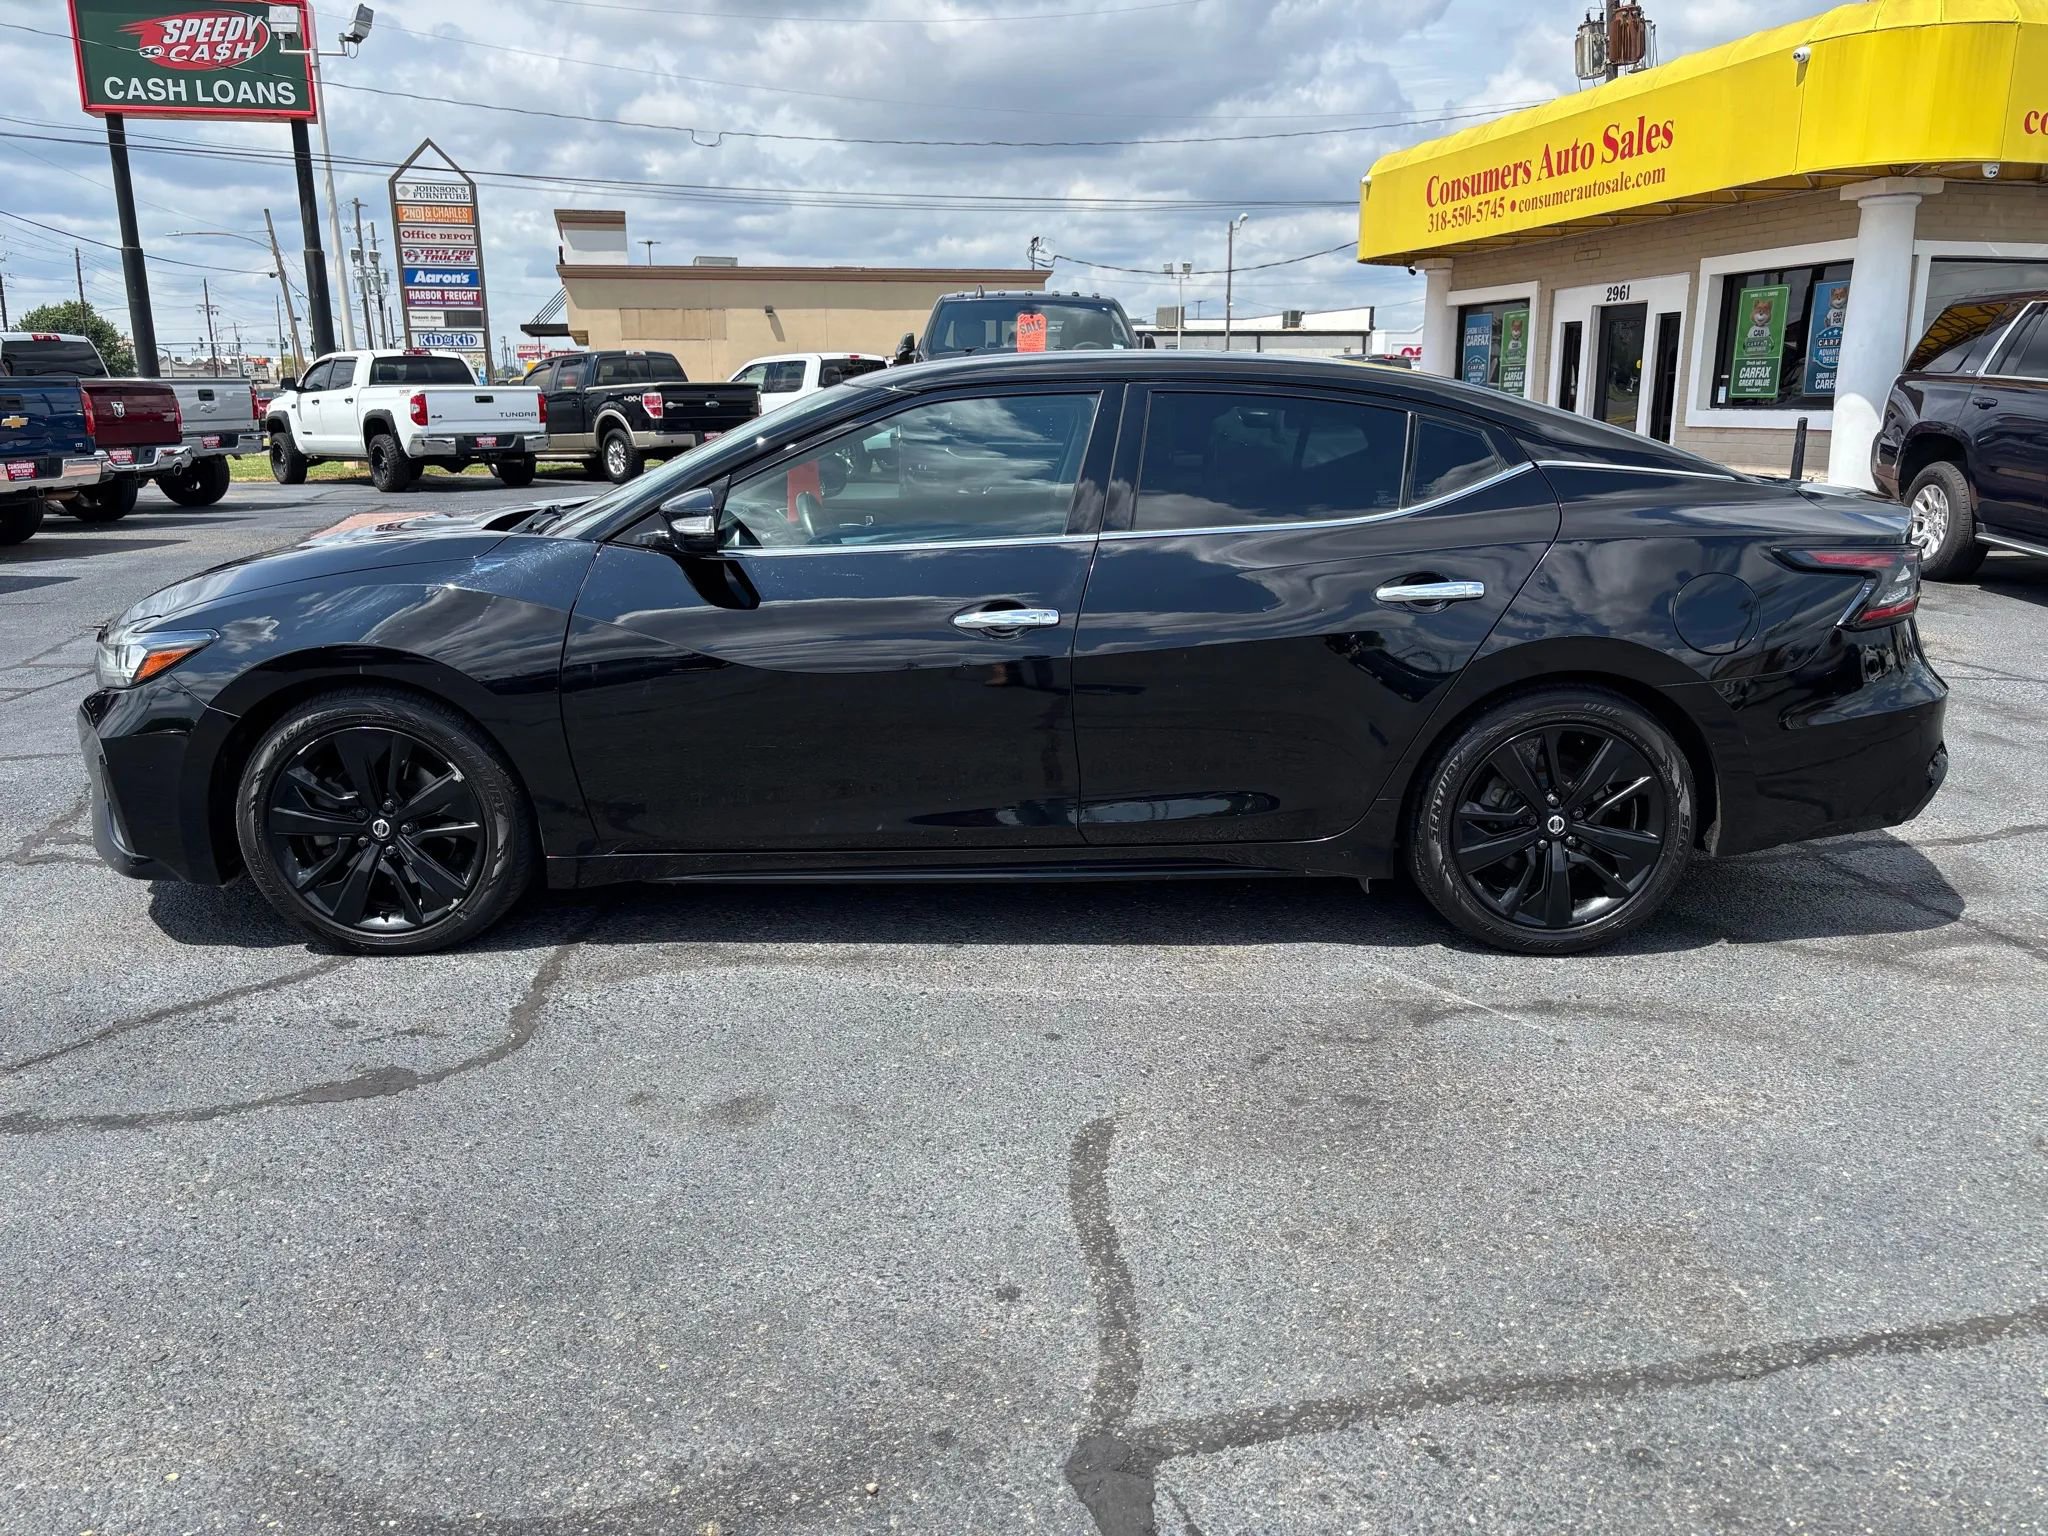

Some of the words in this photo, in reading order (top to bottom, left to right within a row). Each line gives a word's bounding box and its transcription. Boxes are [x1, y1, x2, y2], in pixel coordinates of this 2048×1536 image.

[161, 15, 263, 44] SPEEDY
[104, 76, 188, 101] CASH
[196, 79, 296, 105] LOANS
[1426, 160, 1533, 208] Consumers
[1537, 138, 1595, 182] Auto
[1601, 115, 1675, 165] Sales
[414, 185, 467, 194] JOHNSON'S
[1427, 196, 1506, 234] 318-550-5745
[1518, 167, 1666, 213] consumerautosale.com
[403, 207, 422, 220] 2ND
[424, 207, 432, 218] &
[432, 207, 468, 219] CHARLES
[402, 230, 437, 239] Office
[439, 233, 473, 241] DEPOT
[413, 270, 470, 284] Aaron's
[408, 290, 442, 300] HARBOR
[444, 291, 478, 301] FREIGHT
[1605, 284, 1631, 302] 2961
[1020, 319, 1043, 335] SALE
[1466, 334, 1489, 346] CARFAX
[1740, 367, 1771, 379] CARFAX
[7, 462, 35, 470] CONSUMERS
